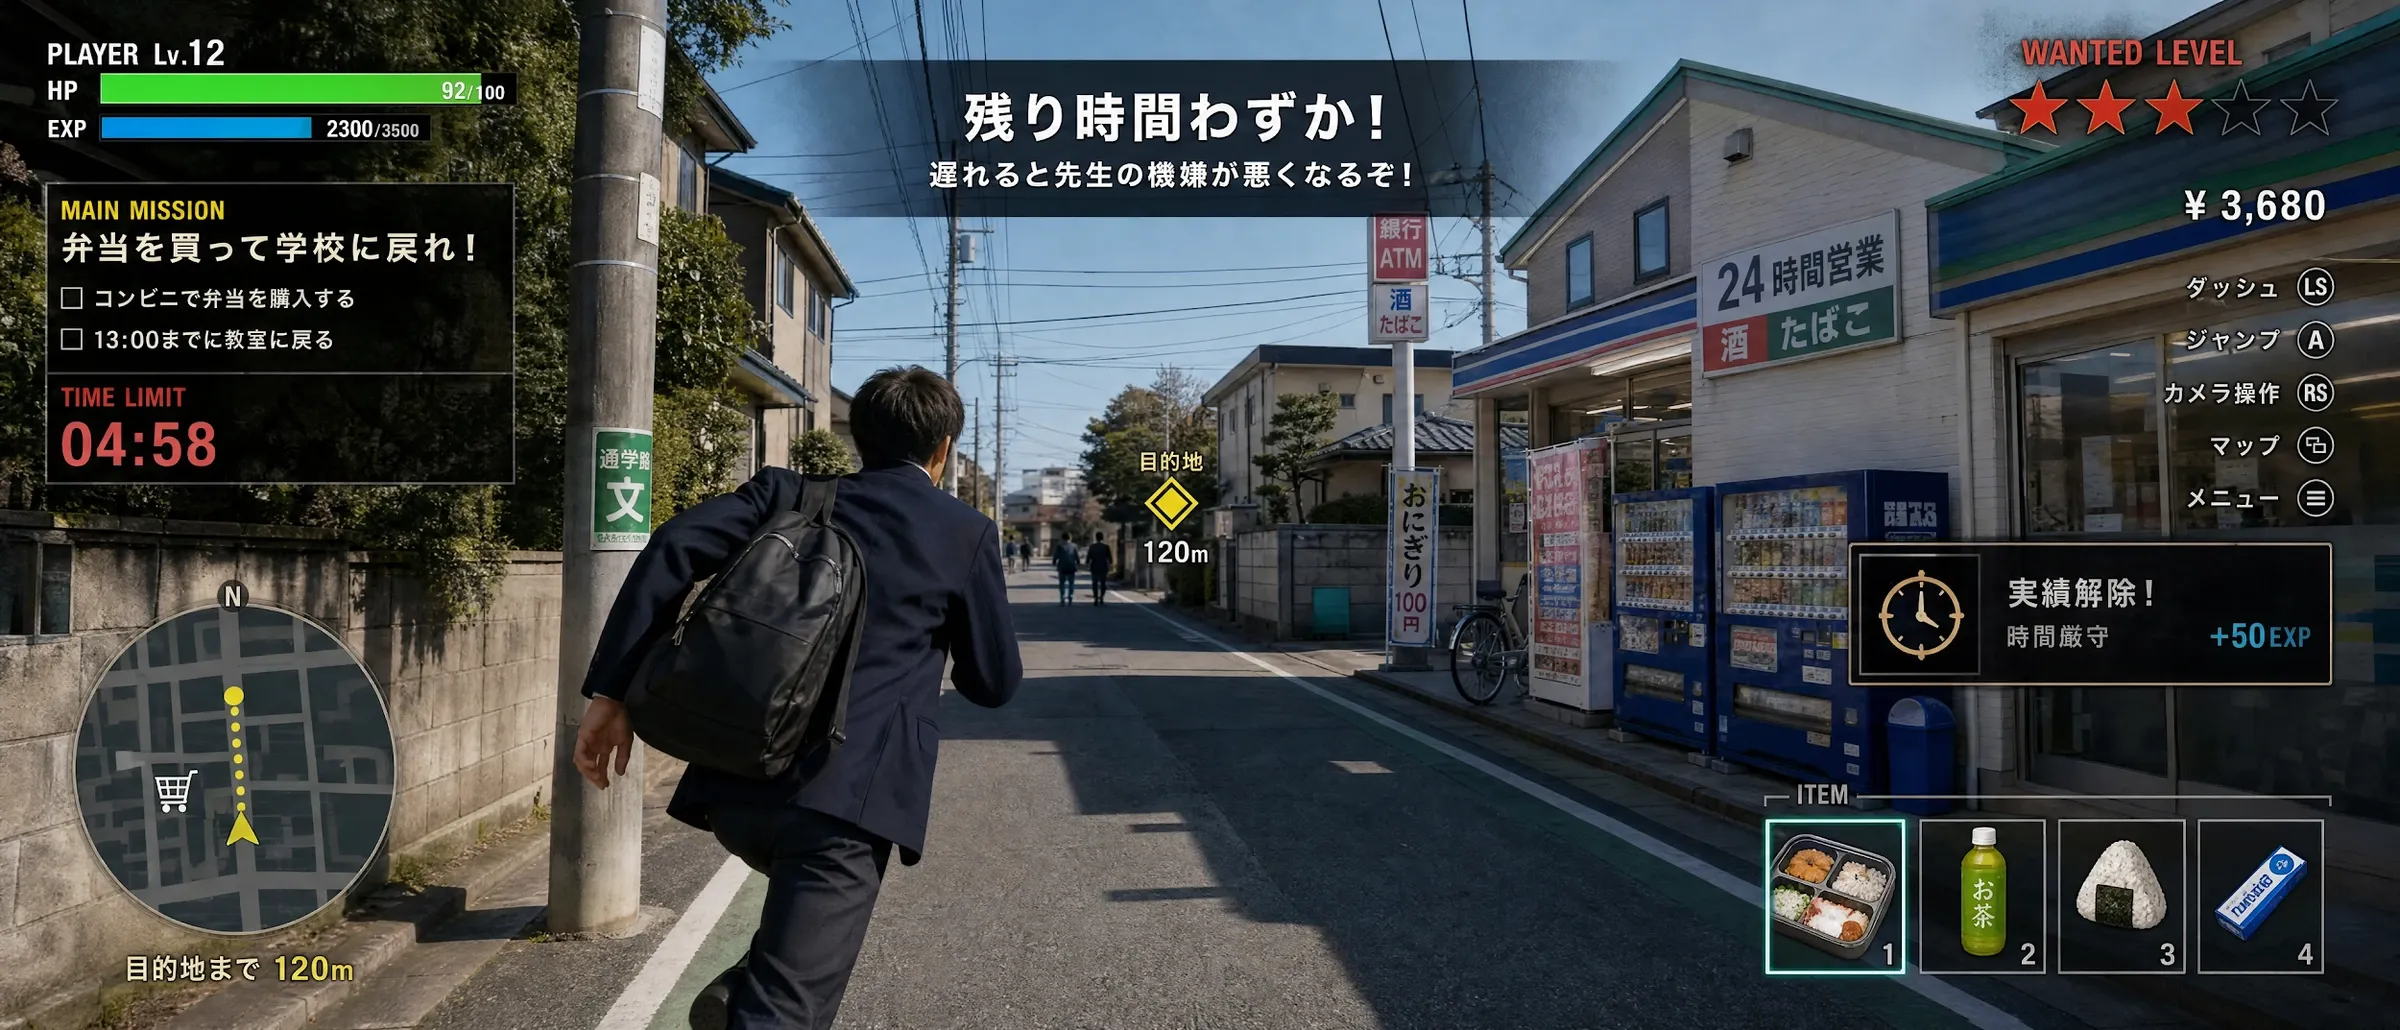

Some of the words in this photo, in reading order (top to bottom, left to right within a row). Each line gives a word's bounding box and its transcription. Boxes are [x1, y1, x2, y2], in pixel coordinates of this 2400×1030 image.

[1380, 218, 1422, 240] 銀行
[1380, 247, 1422, 268] ATM
[1390, 288, 1412, 311] 酒
[1380, 314, 1422, 334] たばこ
[1720, 323, 1749, 363] 酒
[1780, 301, 1871, 351] たばこ
[599, 448, 650, 470] 通学路
[605, 475, 645, 523] 文
[1402, 482, 1428, 588] おにぎり
[1973, 880, 1993, 928] お茶
